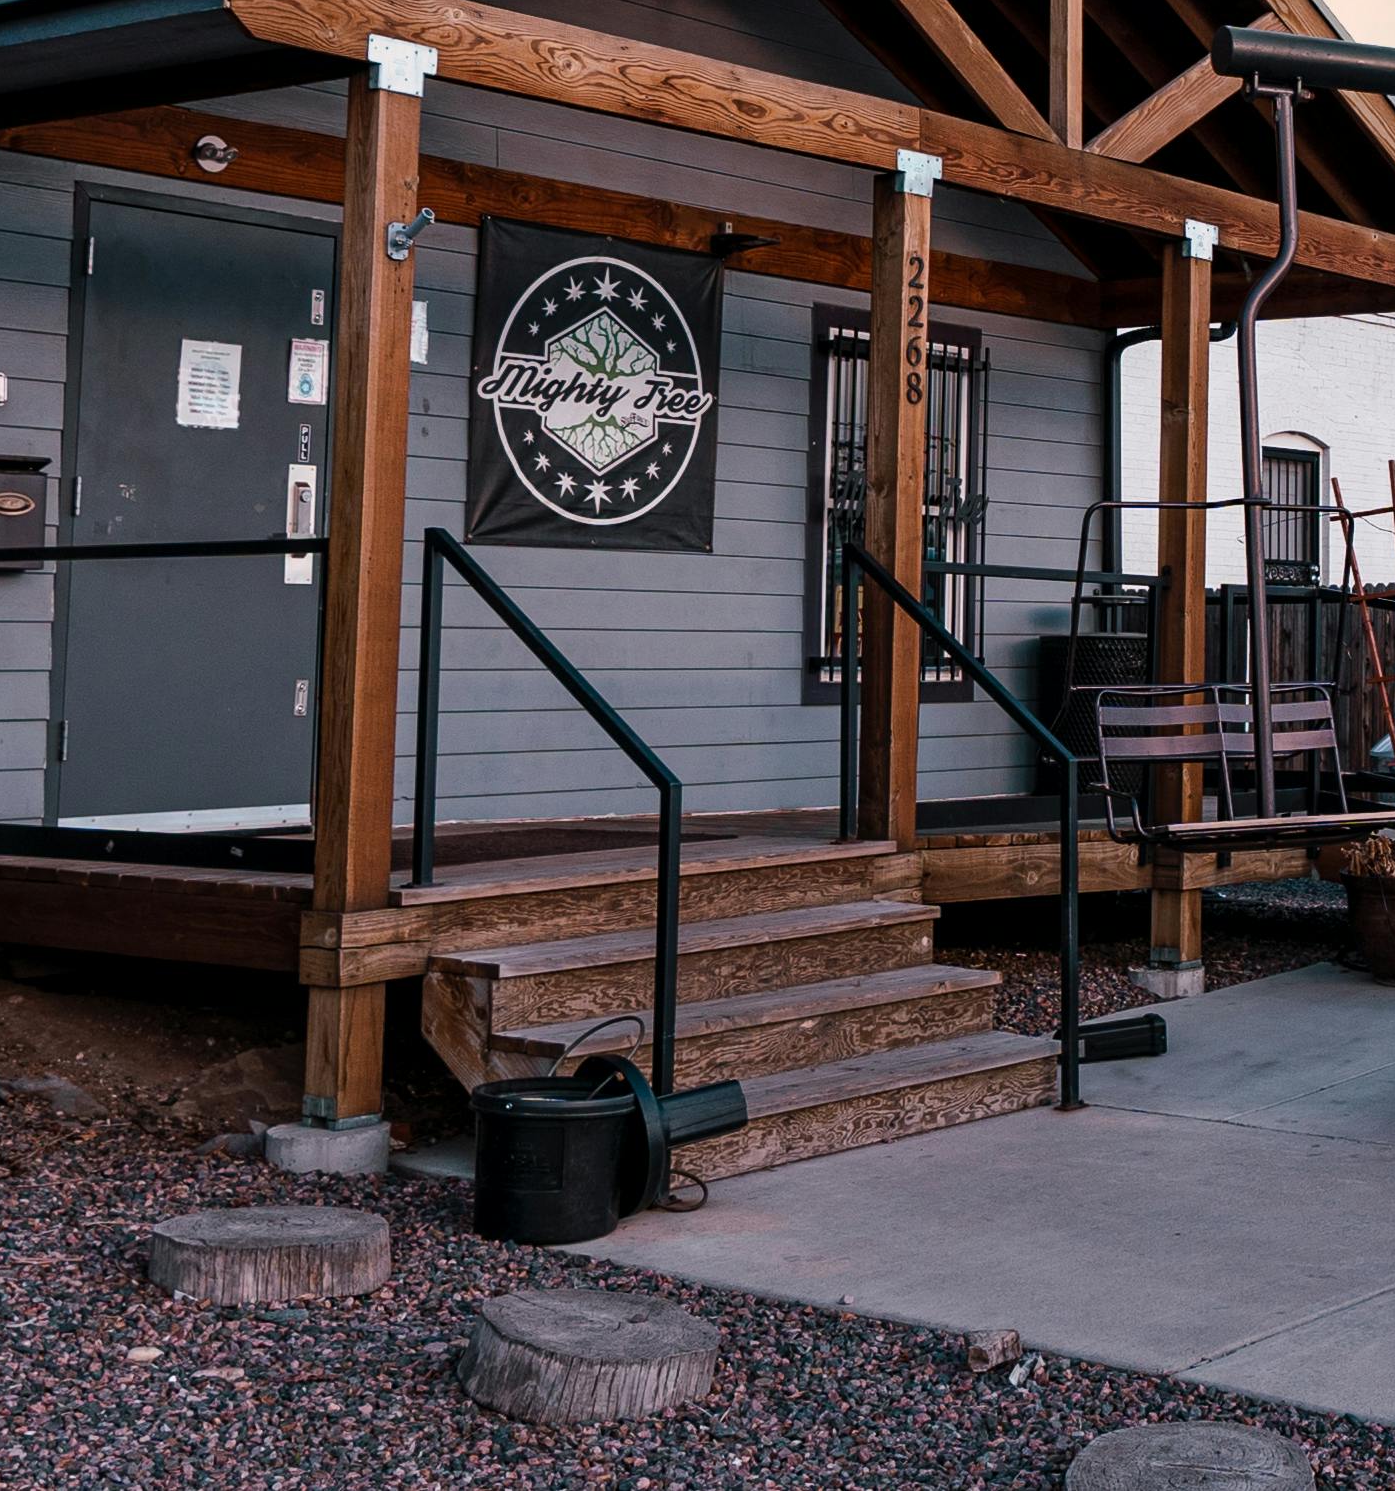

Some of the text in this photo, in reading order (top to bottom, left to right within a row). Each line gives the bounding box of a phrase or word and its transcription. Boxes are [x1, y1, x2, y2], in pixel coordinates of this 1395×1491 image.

[905, 256, 925, 406] 2268
[481, 364, 710, 418] Mighty Tree
[301, 426, 309, 460] PULL
